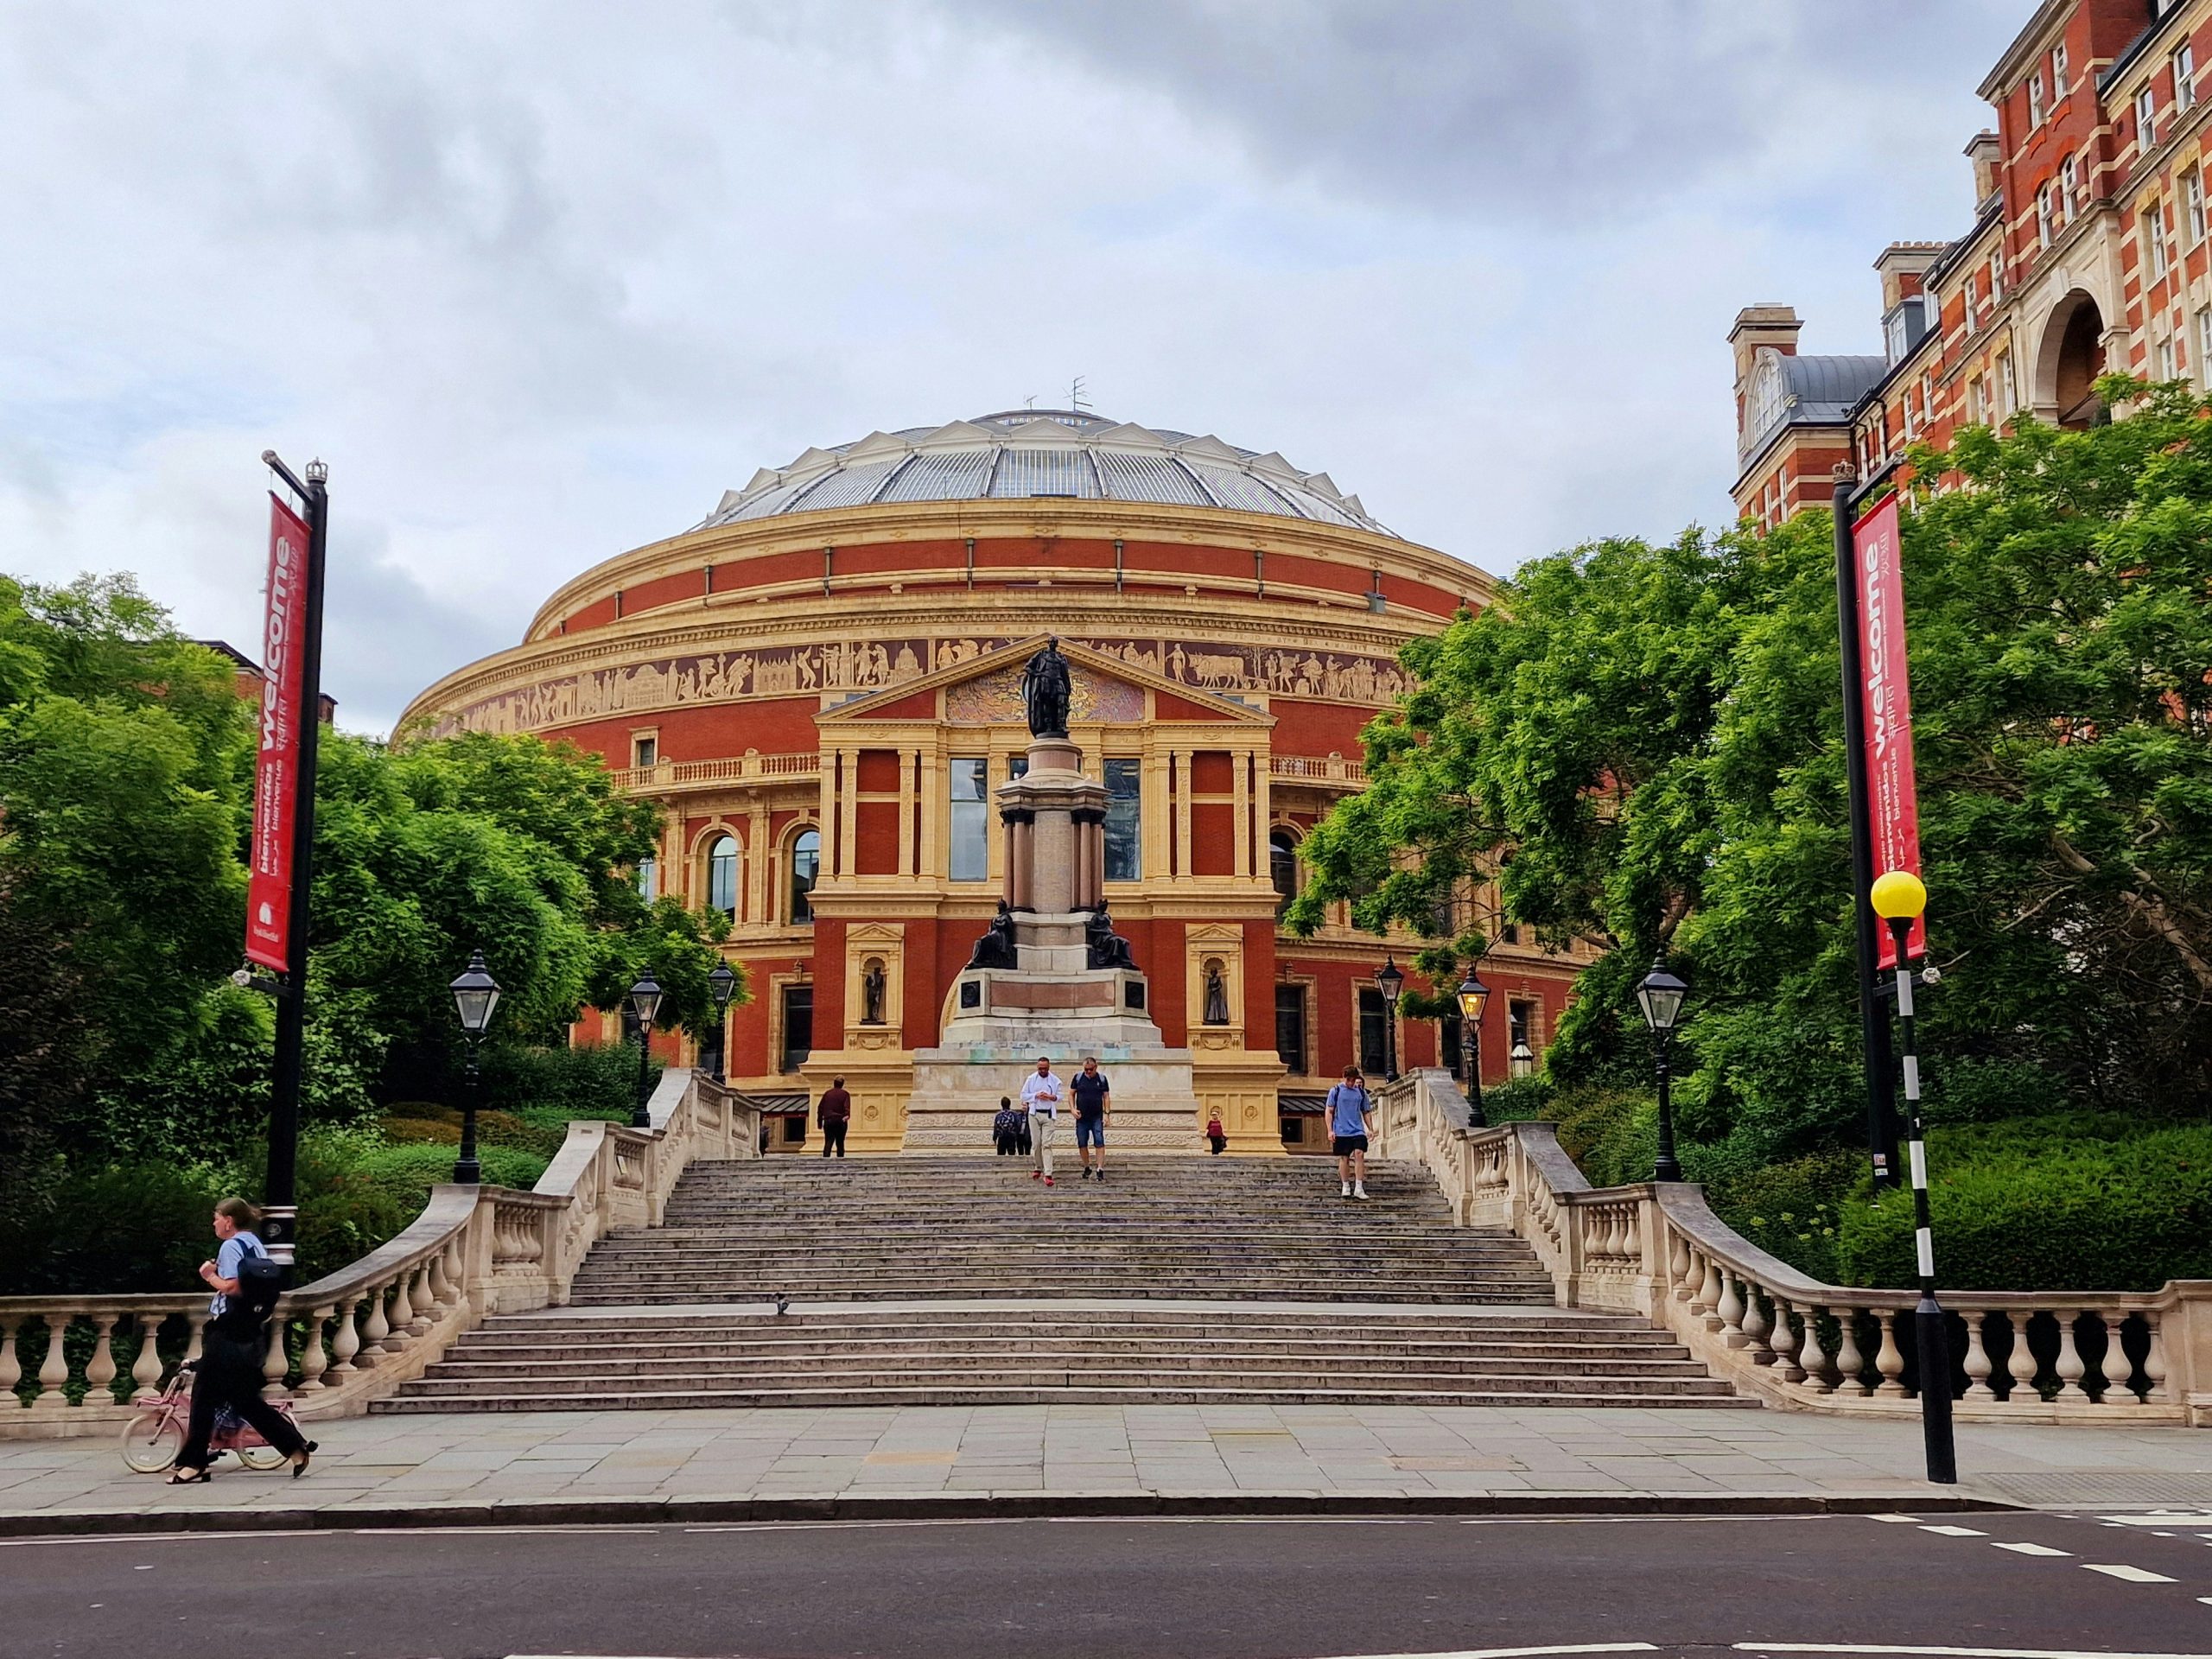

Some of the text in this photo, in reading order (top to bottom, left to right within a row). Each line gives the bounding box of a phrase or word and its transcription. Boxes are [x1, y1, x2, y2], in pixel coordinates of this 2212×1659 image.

[262, 537, 289, 752] welcome
[1866, 542, 1885, 759] welcome
[259, 763, 273, 874] bienvenidos
[271, 759, 283, 830] bienvenue
[1882, 761, 1895, 870] bienvenidos
[1891, 747, 1902, 820] bienvenue
[1914, 1117, 1921, 1128] 1
